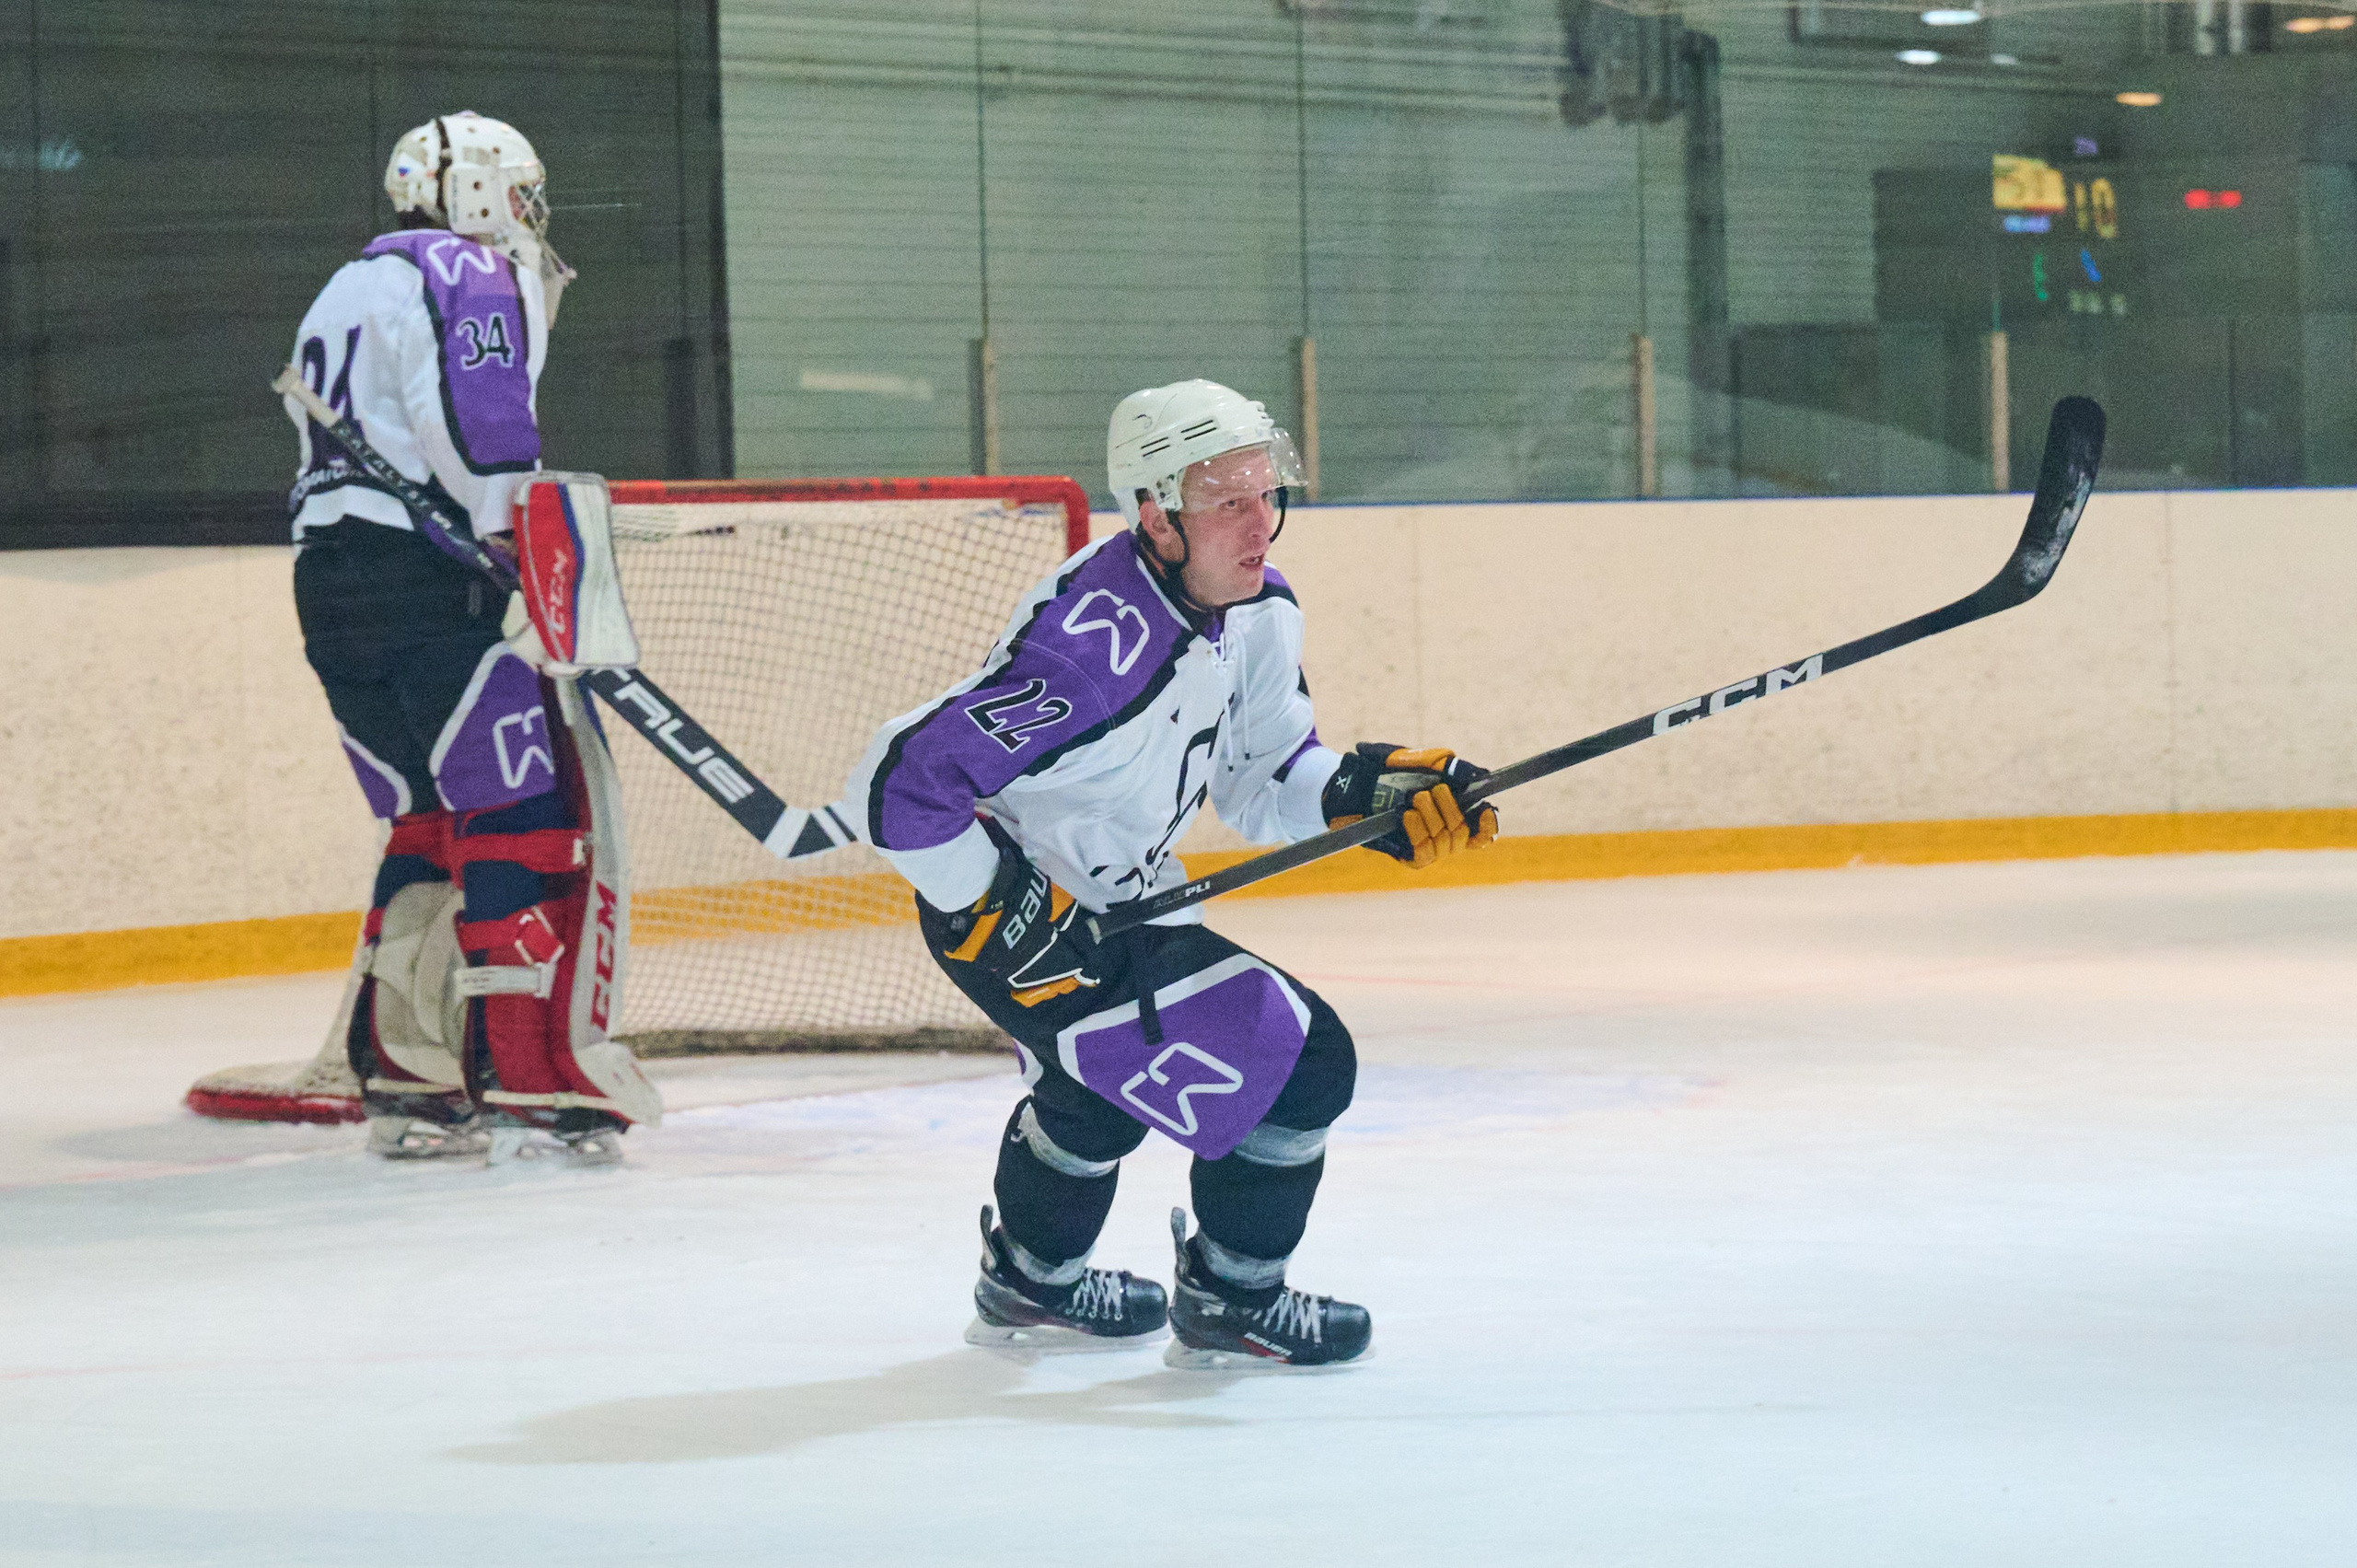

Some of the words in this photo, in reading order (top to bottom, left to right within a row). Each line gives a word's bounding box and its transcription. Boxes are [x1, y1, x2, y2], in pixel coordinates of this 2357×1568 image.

[455, 312, 516, 371] 34
[549, 549, 568, 633] CCM
[964, 679, 1073, 754] 22
[1653, 653, 1824, 735] CCM
[590, 879, 618, 1032] CCM
